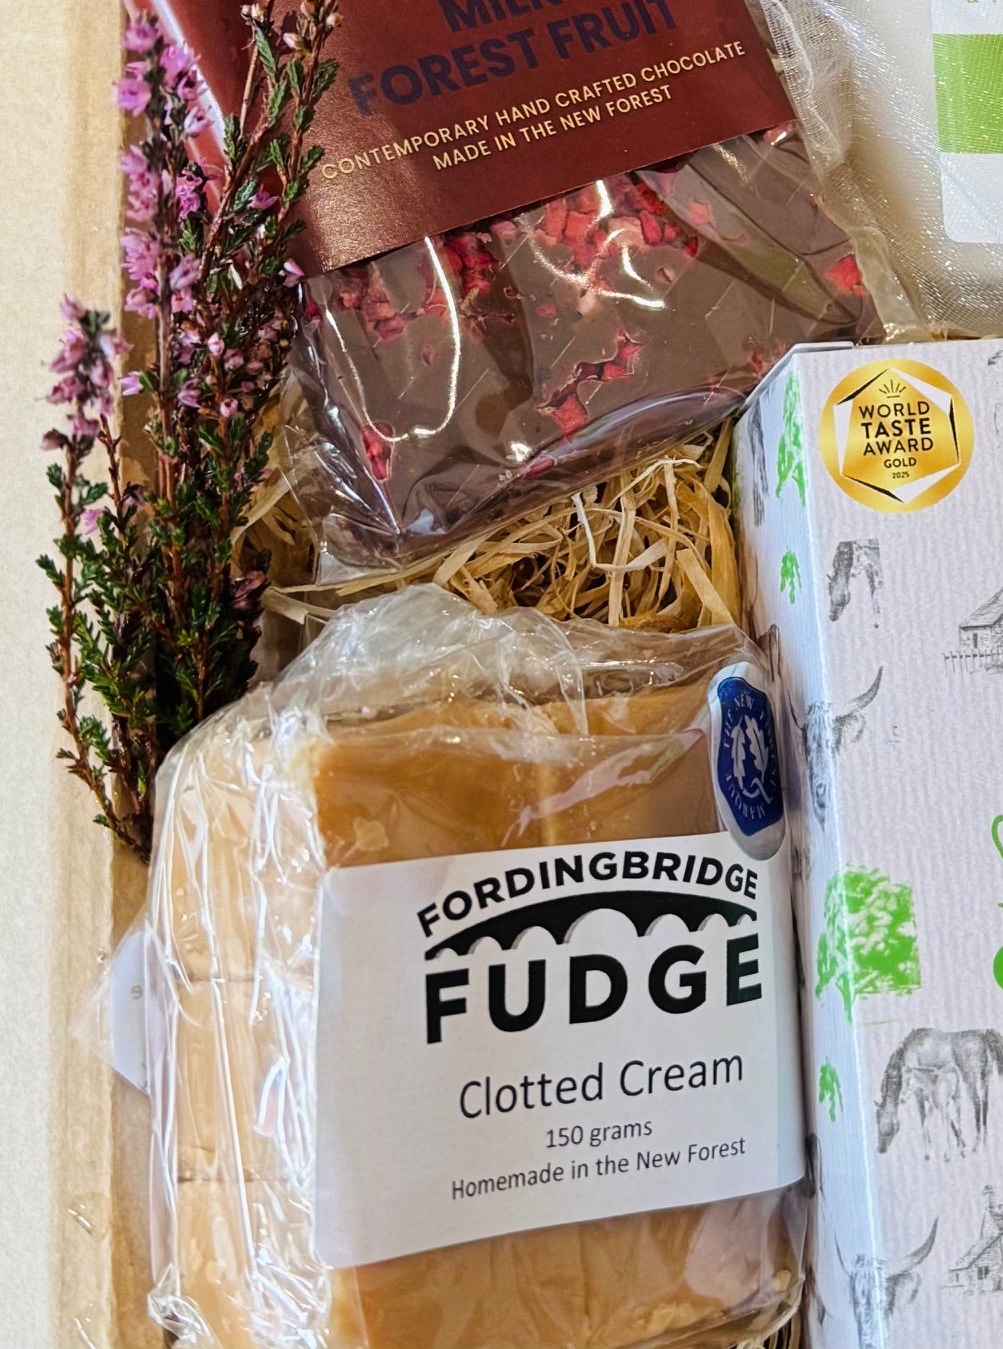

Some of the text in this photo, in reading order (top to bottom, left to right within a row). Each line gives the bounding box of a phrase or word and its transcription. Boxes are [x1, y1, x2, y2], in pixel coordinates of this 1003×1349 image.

[347, 27, 541, 118] FOREST
[321, 40, 746, 181] CONTEMPORARY HAND CRAFTED CHOCOLATE
[433, 84, 673, 170] MADE IN THE NEW FOREST
[859, 401, 930, 419] WORLD
[861, 417, 931, 439] TASTE
[863, 437, 934, 456] AWARD
[884, 456, 917, 469] GOLD
[417, 850, 759, 939] FORDINGBRIDGE
[424, 932, 763, 1046] FUDGE
[459, 1053, 744, 1120] Clotted Cream
[545, 1118, 653, 1149] 150 grams
[451, 1137, 747, 1201] Homemade in the New Forest
